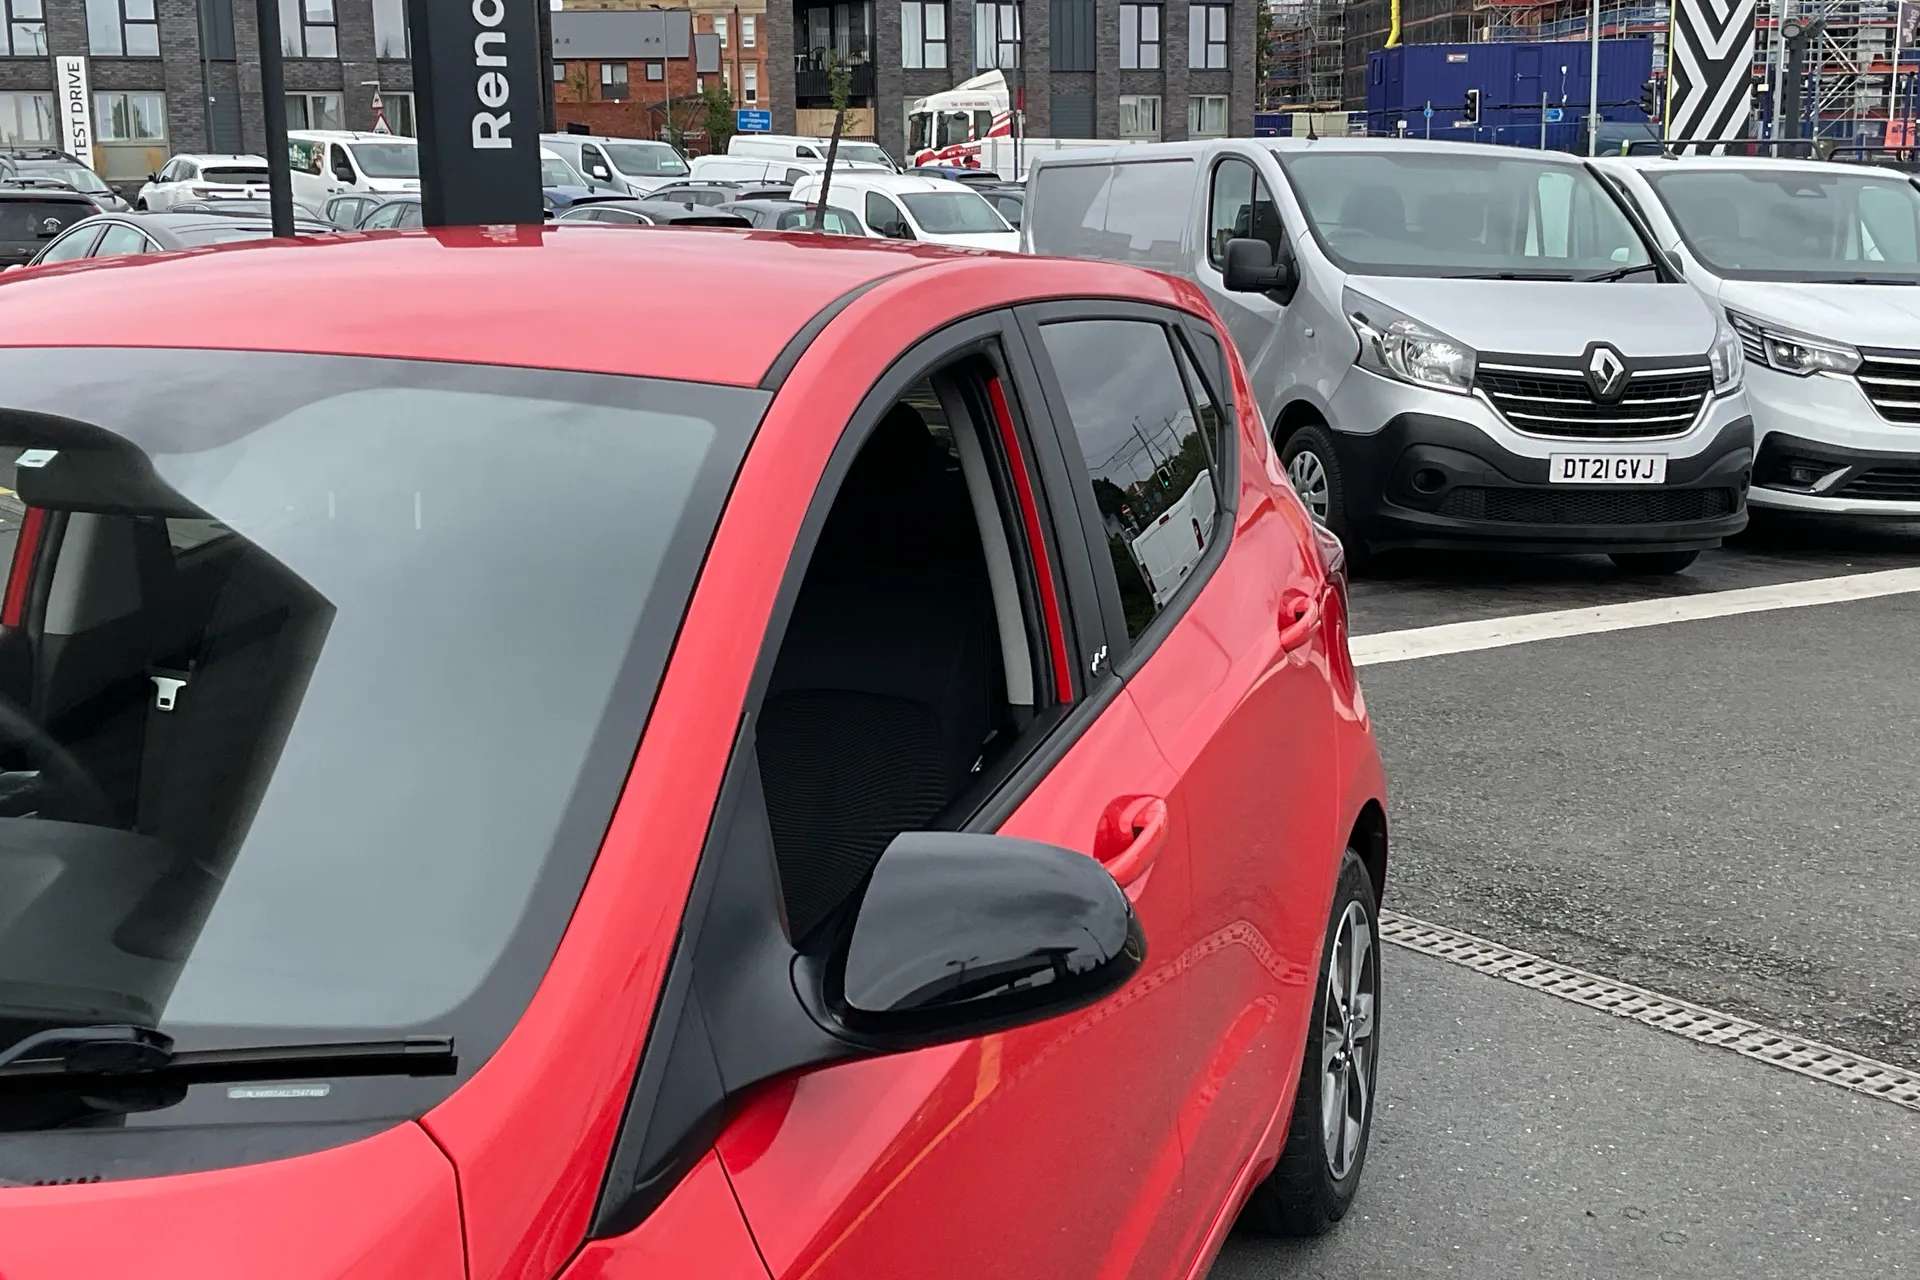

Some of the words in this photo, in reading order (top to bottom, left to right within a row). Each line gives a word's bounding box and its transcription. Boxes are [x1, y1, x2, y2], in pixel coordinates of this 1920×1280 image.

[67, 62, 83, 113] DRIVE
[72, 118, 87, 157] TEST
[1563, 458, 1610, 479] DT21
[1615, 458, 1654, 479] GVJ
